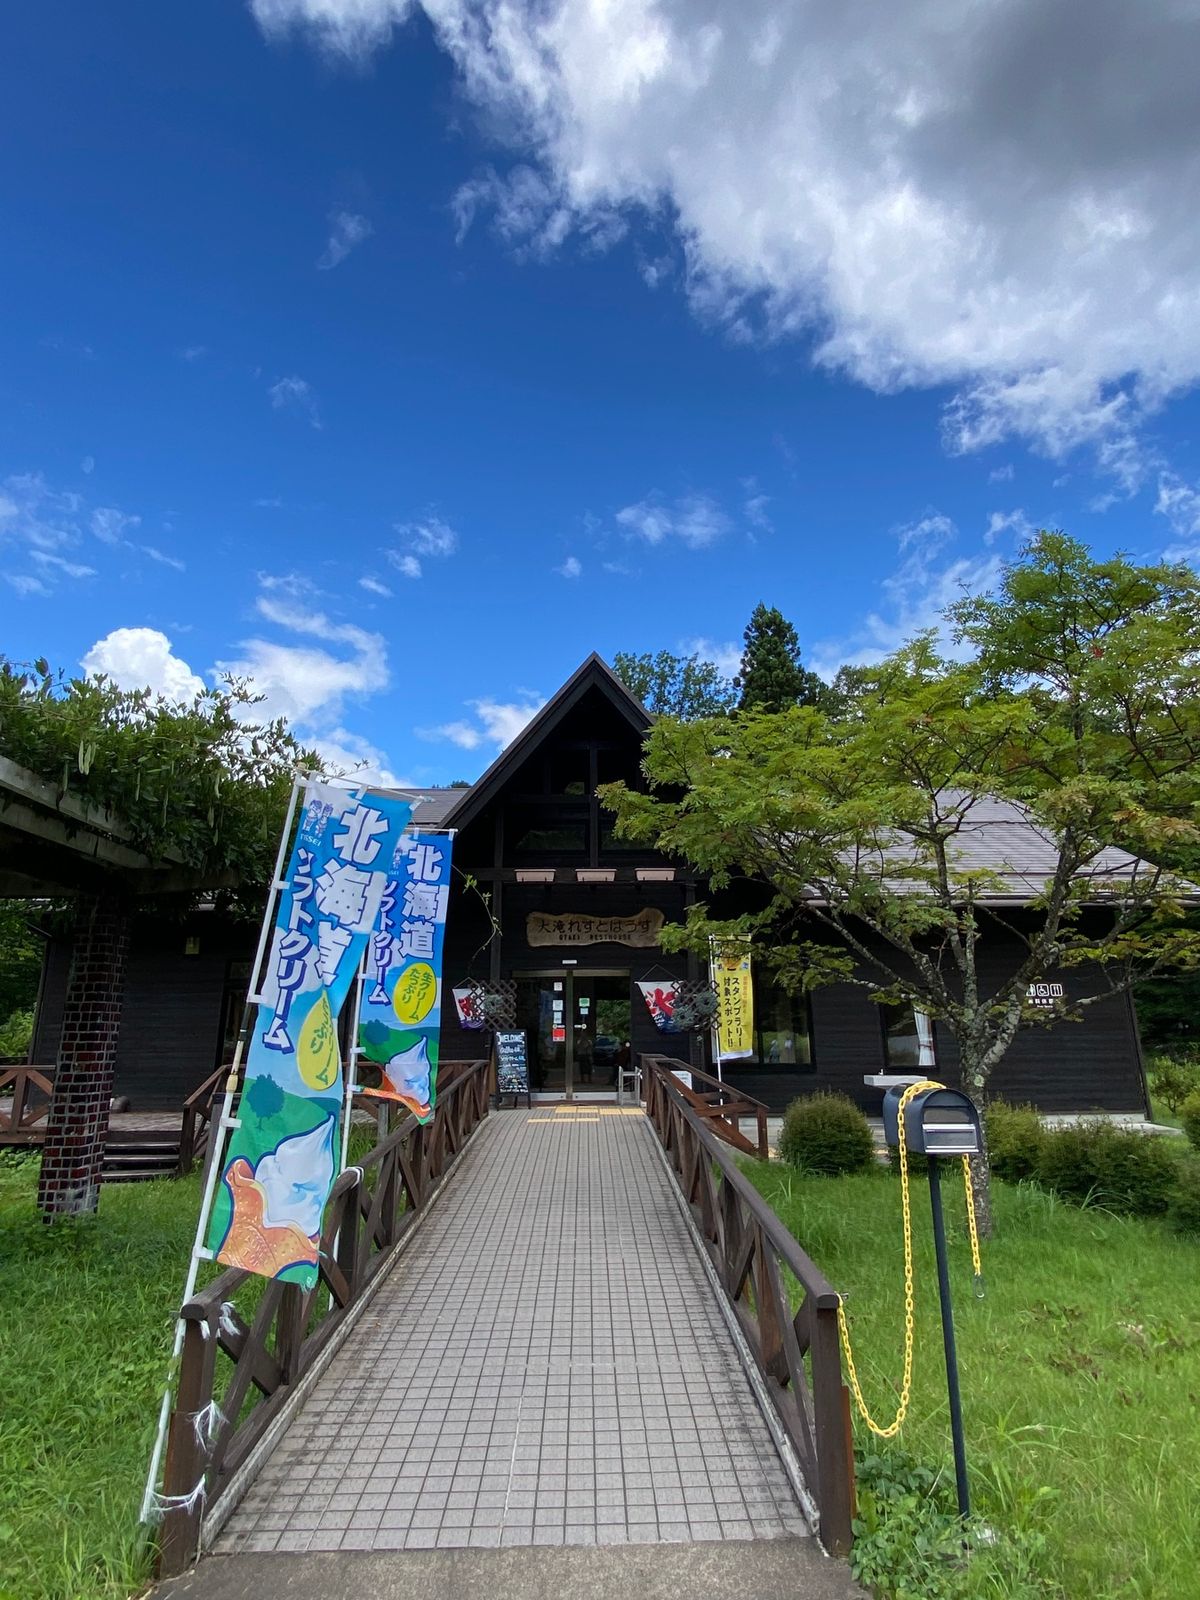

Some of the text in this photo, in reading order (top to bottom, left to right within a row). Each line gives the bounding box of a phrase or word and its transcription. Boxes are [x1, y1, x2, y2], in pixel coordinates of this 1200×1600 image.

[368, 880, 398, 1007] ソフトクリーム
[399, 843, 443, 960] 北海道
[262, 847, 316, 1055] ソフトクリーム
[402, 968, 420, 1004] たっぷり
[409, 971, 433, 1021] 生クリーム
[732, 977, 743, 1047] スタンプラリー
